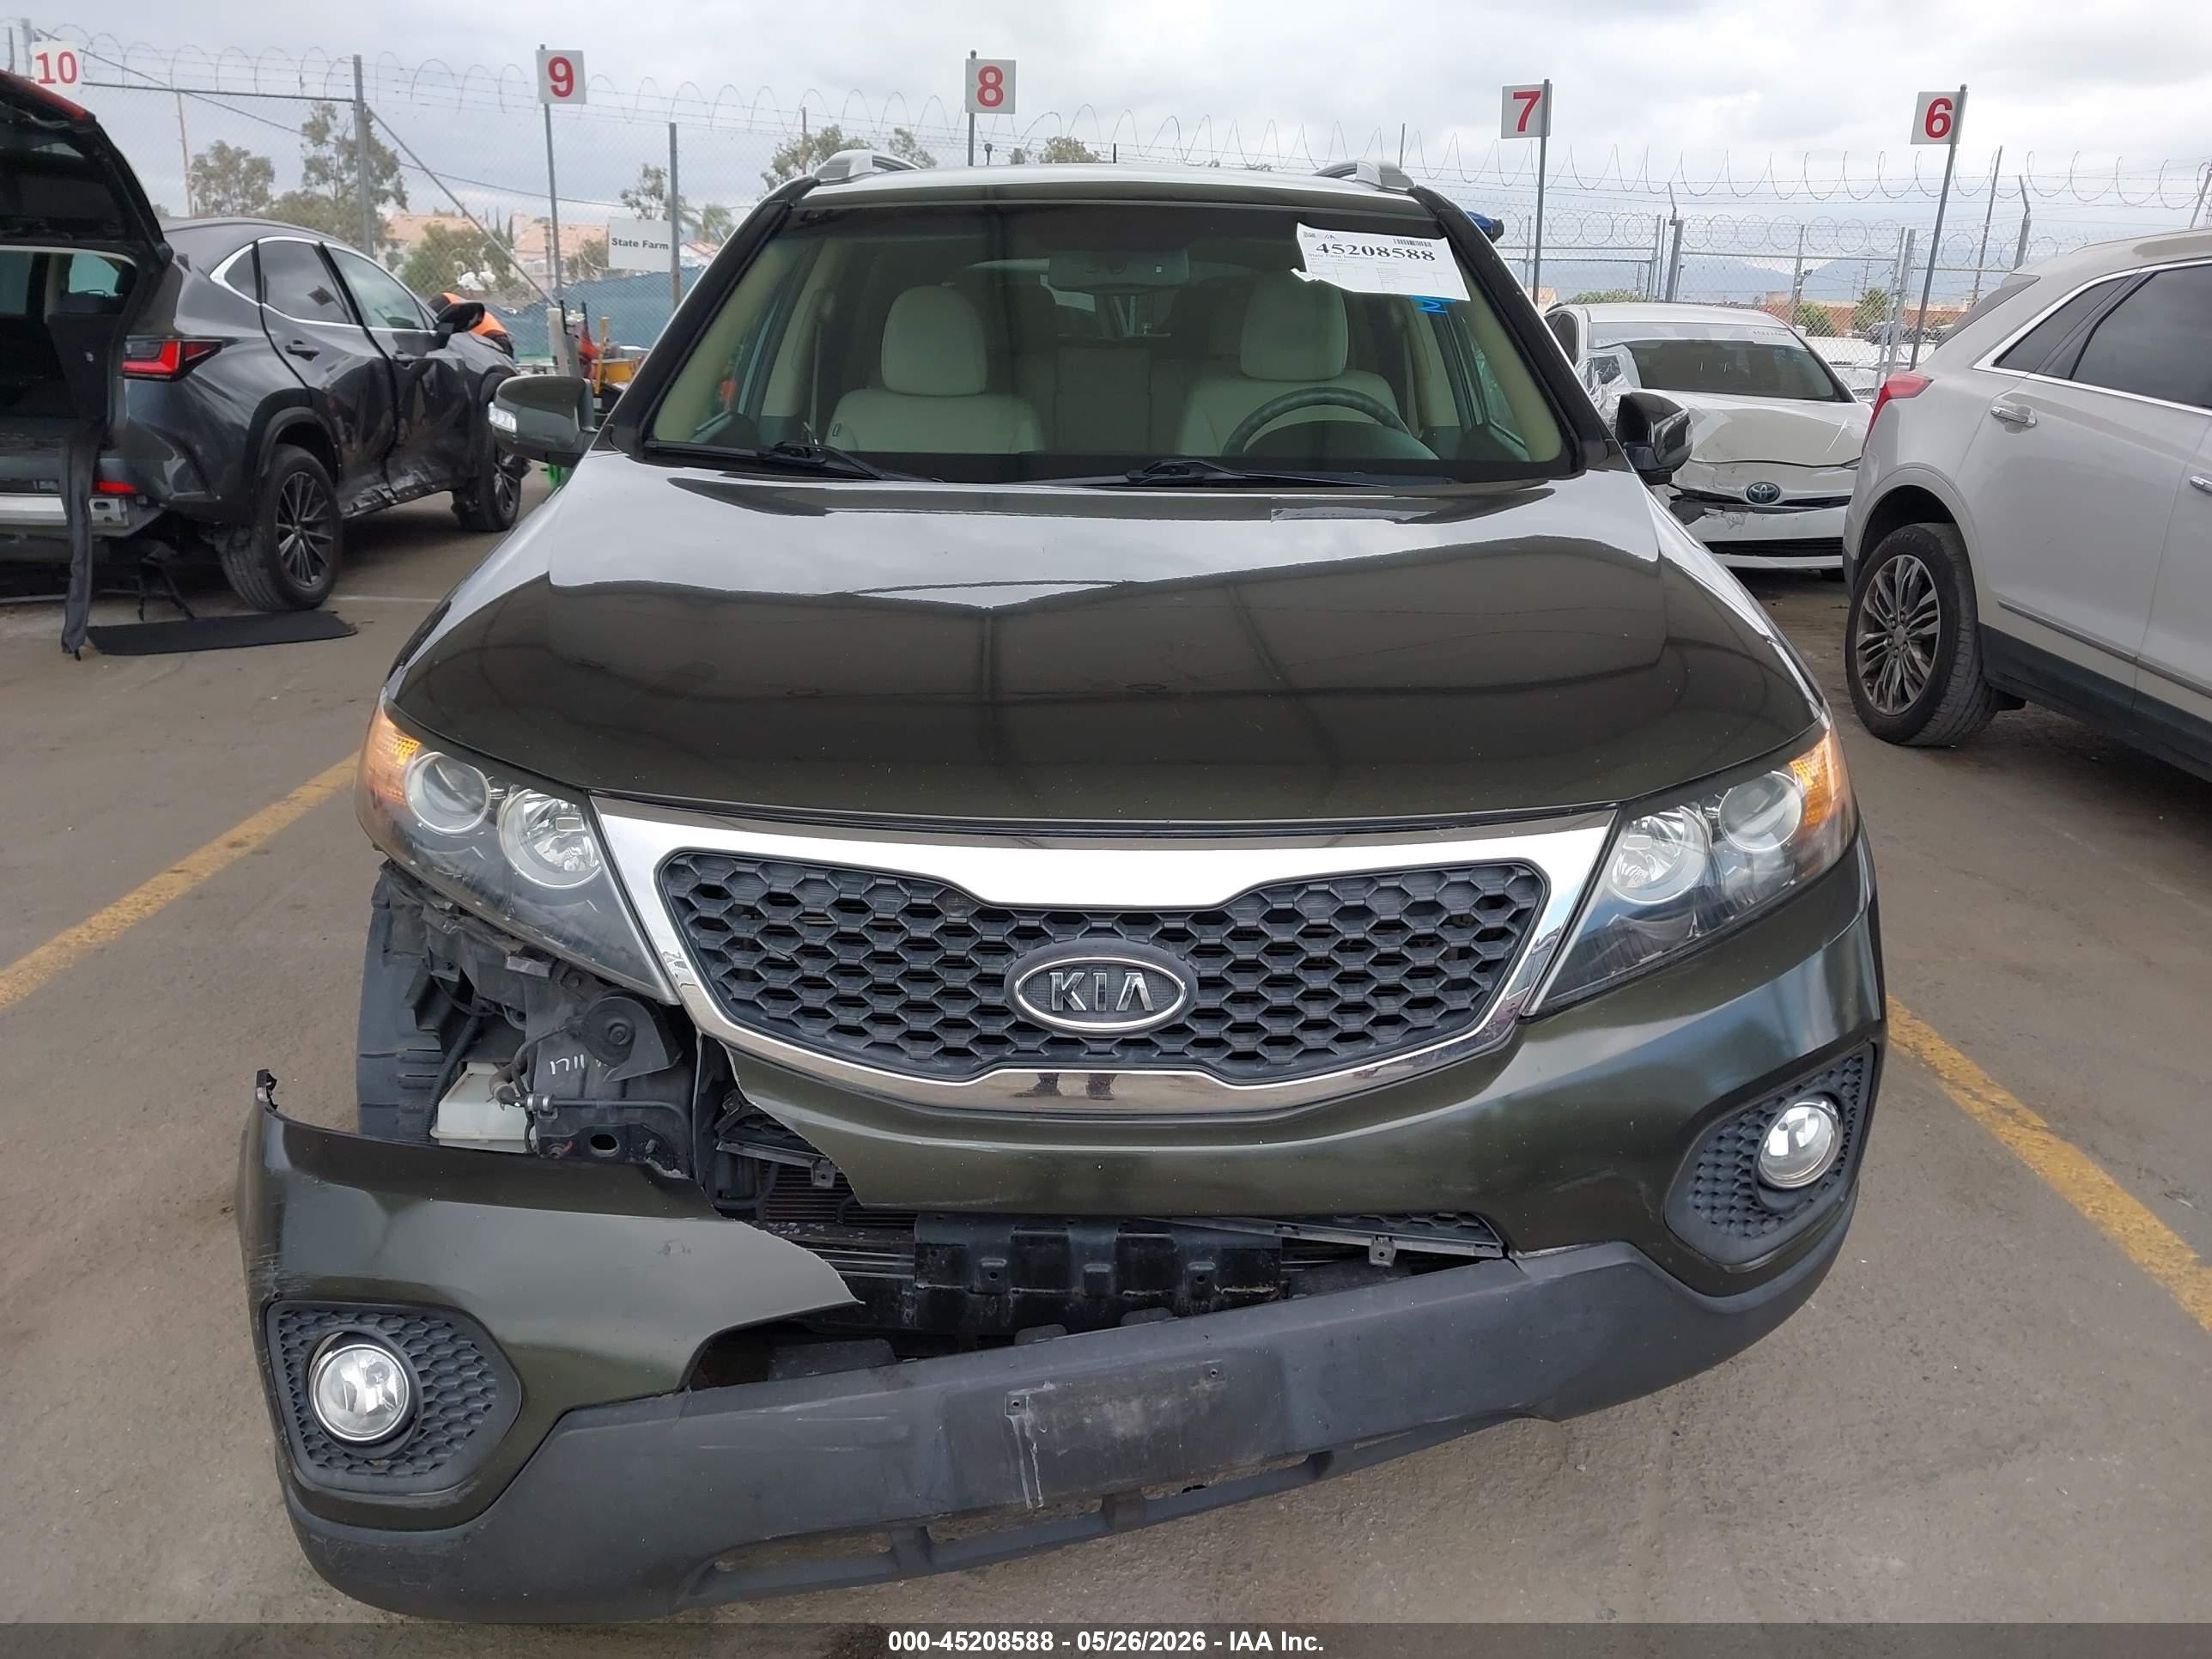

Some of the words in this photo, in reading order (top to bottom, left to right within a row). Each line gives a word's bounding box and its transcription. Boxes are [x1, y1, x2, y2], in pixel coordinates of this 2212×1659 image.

[35, 51, 77, 84] 10
[548, 56, 574, 98] 9
[977, 65, 1004, 107] 8
[1513, 90, 1541, 132] 7
[1925, 97, 1953, 138] 6
[611, 237, 639, 247] State
[642, 240, 669, 250] Farm
[1316, 242, 1436, 262] 45208588
[1048, 969, 1155, 1012] KIA
